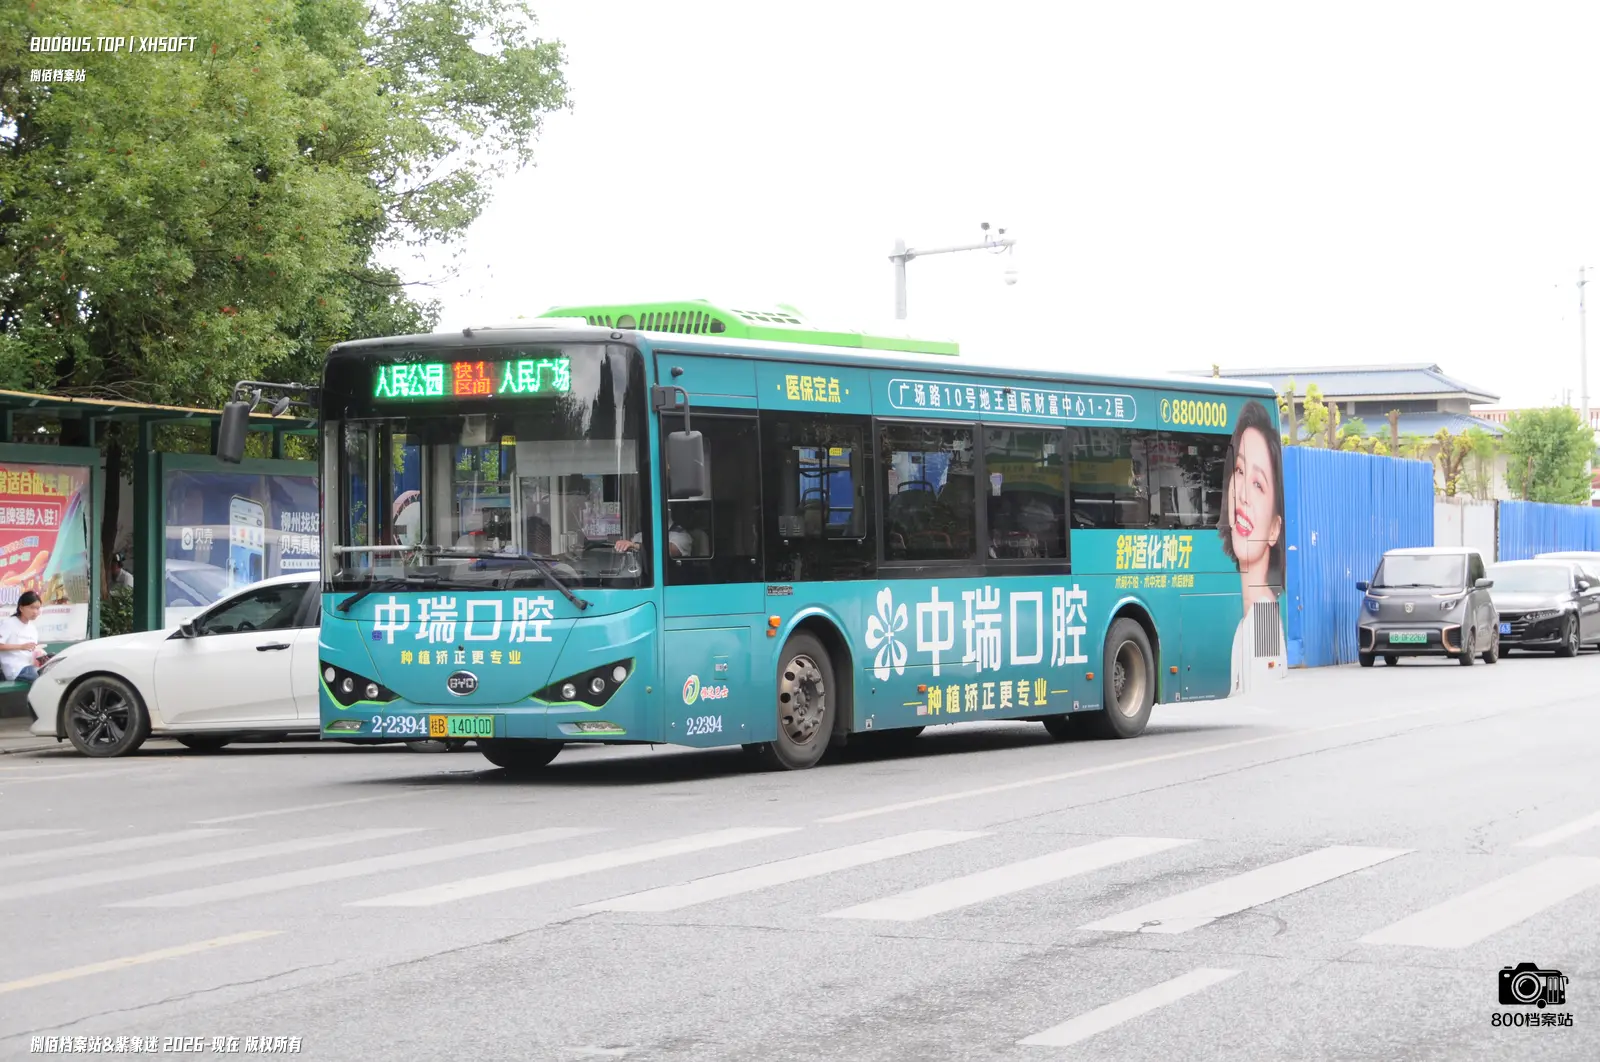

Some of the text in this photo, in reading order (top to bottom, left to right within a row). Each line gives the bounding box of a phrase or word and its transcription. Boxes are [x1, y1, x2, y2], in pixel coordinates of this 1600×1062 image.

[375, 363, 444, 397] 人民公园
[498, 358, 570, 393] 人民广场
[1172, 399, 1228, 428] 8800000
[195, 528, 213, 544] 贝壳
[1115, 534, 1193, 570] 舒适化种牙
[372, 595, 554, 644] 中瑞口腔
[915, 583, 1088, 677] 中瑞口腔
[400, 650, 522, 665] 种植矫正更专业
[450, 678, 474, 688] BYD
[927, 677, 1048, 715] 种植矫正更专业
[372, 715, 427, 734] 2-2394
[686, 715, 723, 736] 2-2394
